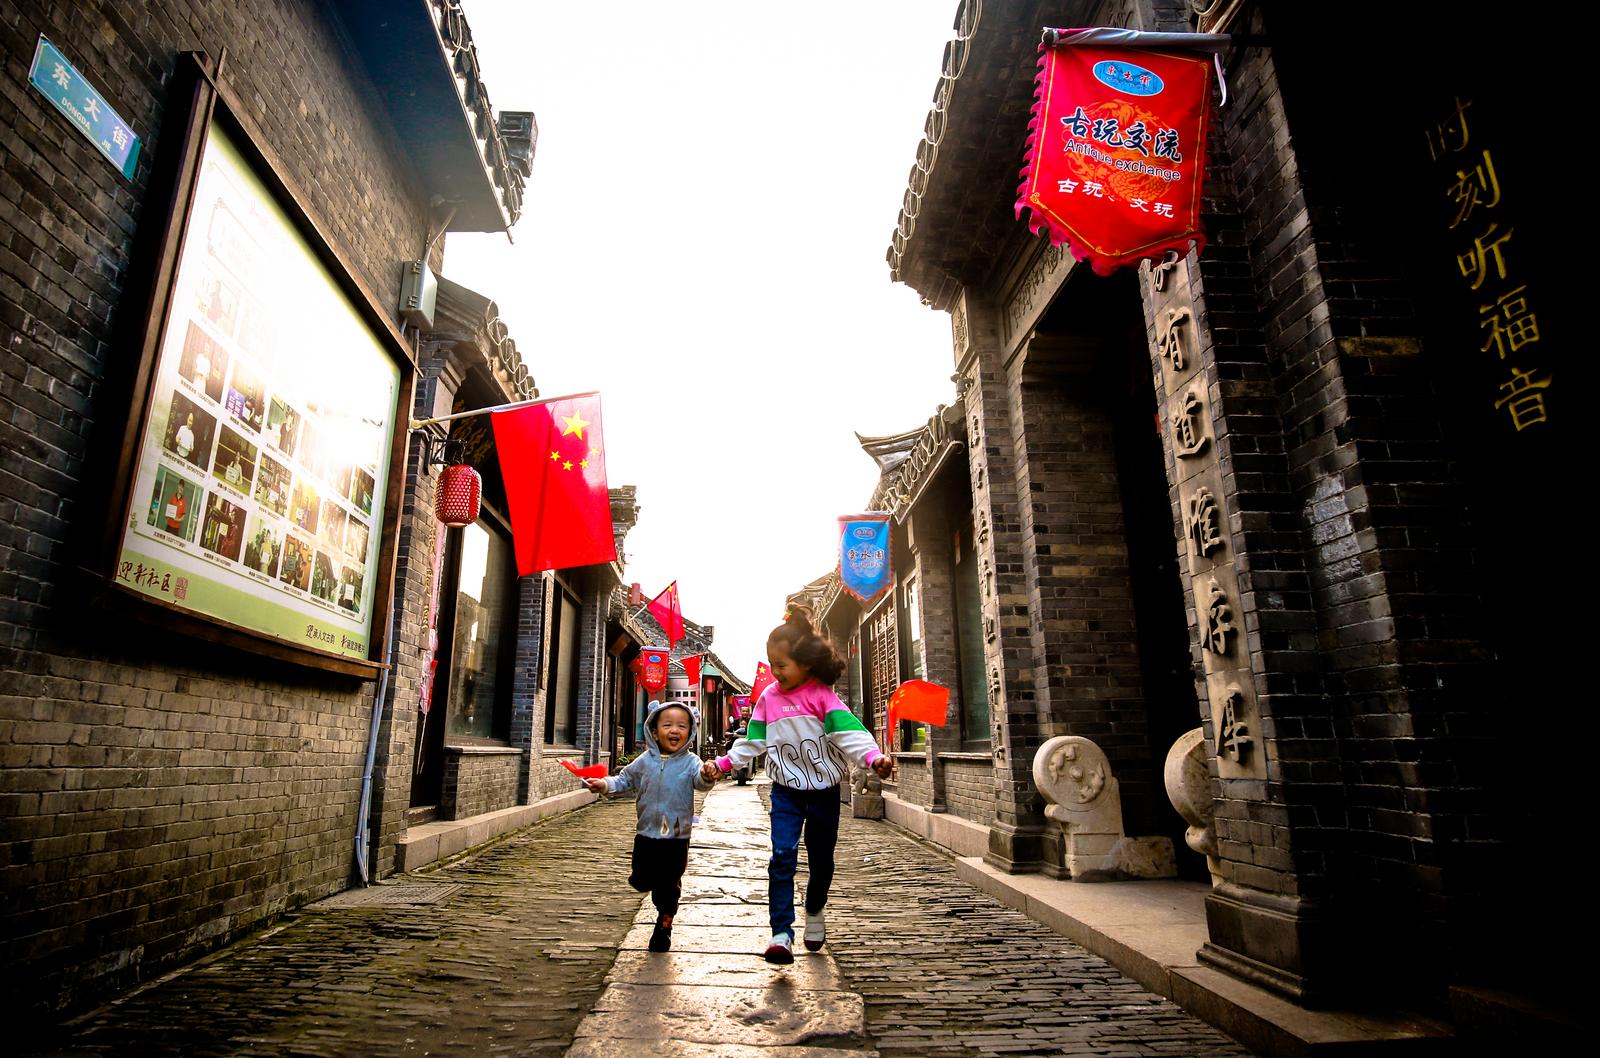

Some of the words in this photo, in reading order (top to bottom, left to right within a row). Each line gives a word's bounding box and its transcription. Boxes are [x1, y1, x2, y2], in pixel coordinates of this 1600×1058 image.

[52, 62, 128, 150] 东大街
[61, 97, 91, 130] DONGDA
[101, 139, 112, 151] JIE
[1061, 106, 1182, 163] 古玩交流
[1064, 138, 1112, 166] Antique
[1116, 155, 1181, 182] exchange
[1425, 96, 1552, 432] 时刻听福音
[116, 561, 171, 592] 迎新社区
